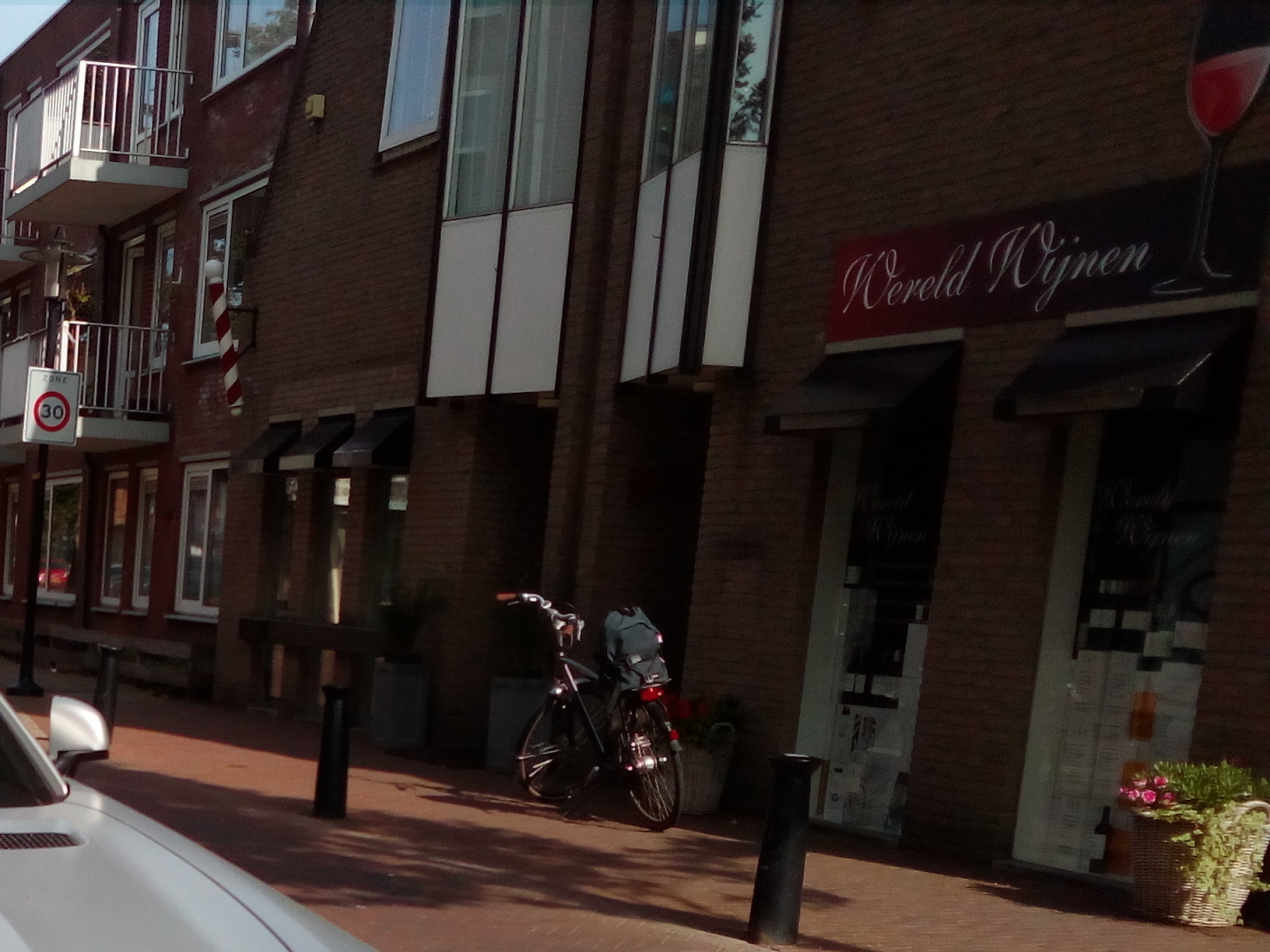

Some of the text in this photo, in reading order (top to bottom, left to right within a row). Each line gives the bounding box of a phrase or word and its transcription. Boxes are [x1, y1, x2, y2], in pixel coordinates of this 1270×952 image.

[843, 220, 1153, 314] Wereld Wijnen
[42, 375, 68, 384] ZONE
[41, 404, 63, 420] 30
[867, 515, 927, 554] Wijnen
